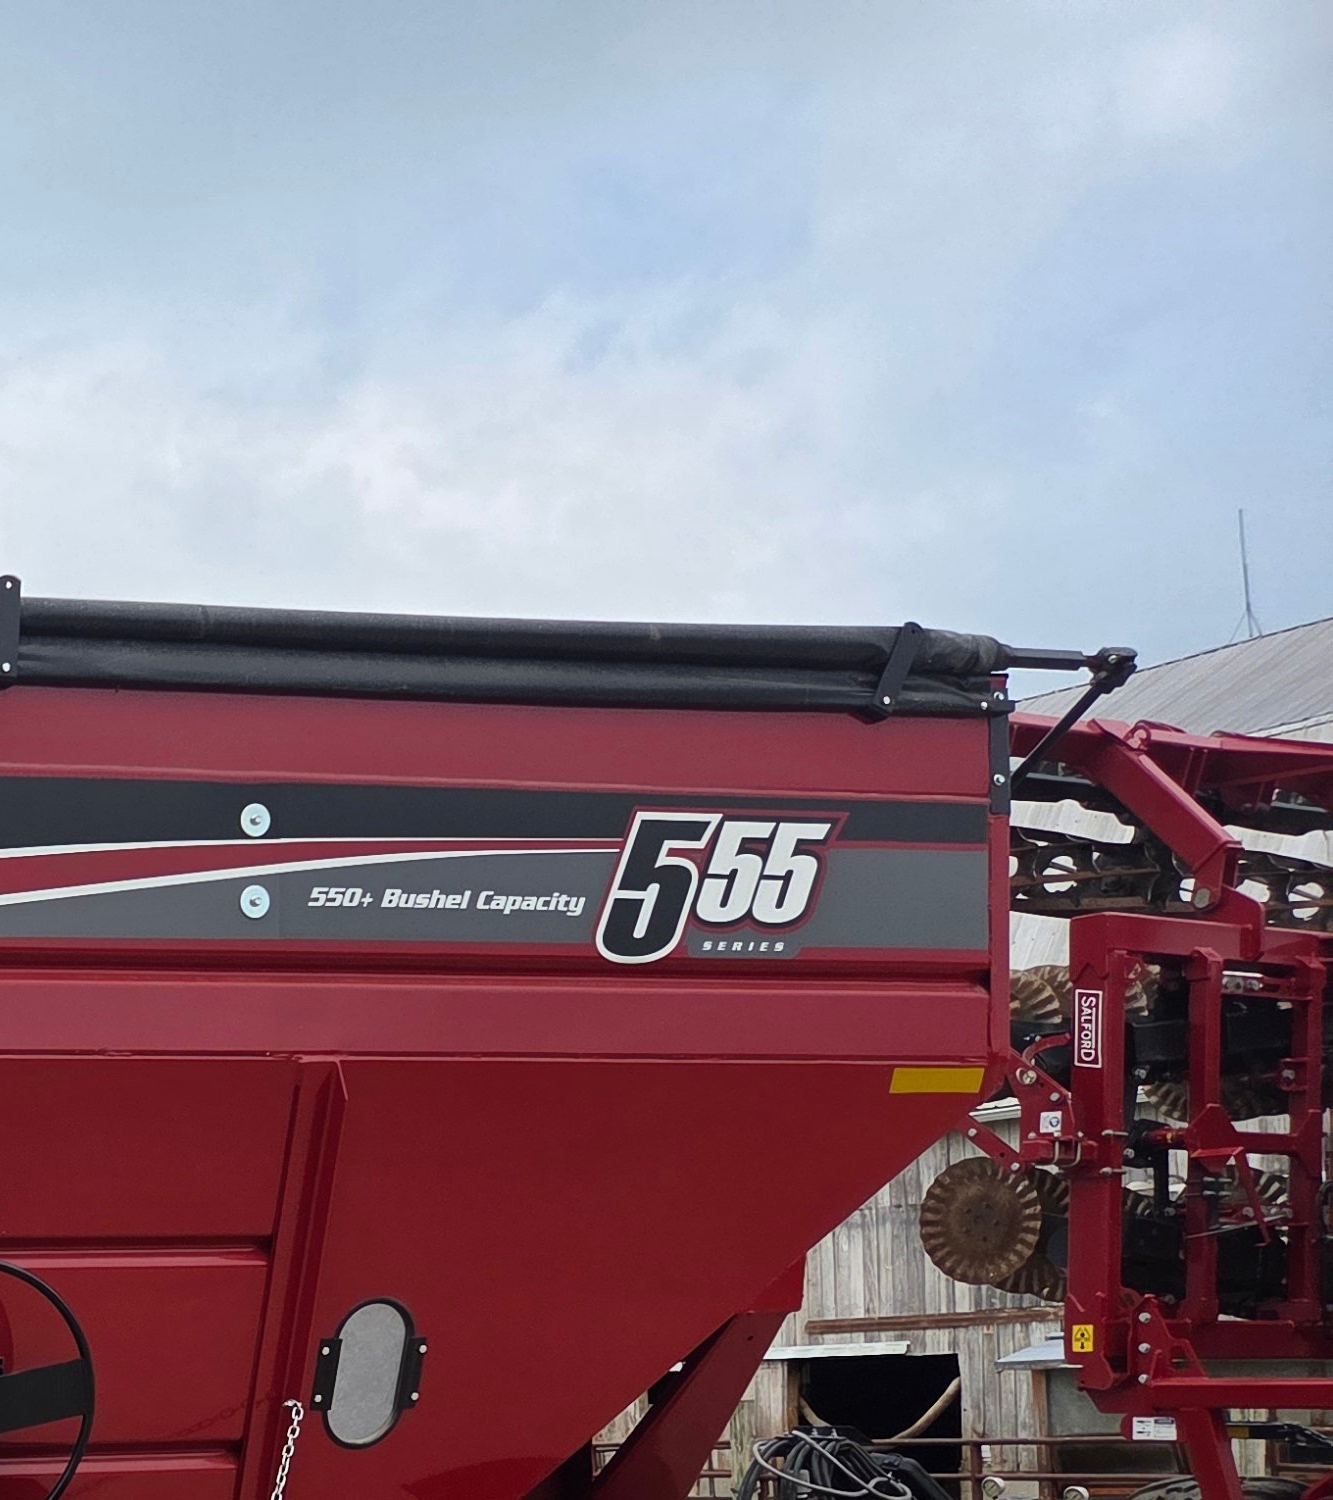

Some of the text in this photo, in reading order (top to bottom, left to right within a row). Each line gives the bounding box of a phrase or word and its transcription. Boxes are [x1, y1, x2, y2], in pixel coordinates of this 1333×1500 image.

[308, 886, 586, 917] 550+ Bushel Capacity
[595, 811, 832, 964] 555
[701, 940, 785, 952] SERIES
[1081, 995, 1097, 1063] SALFORD
